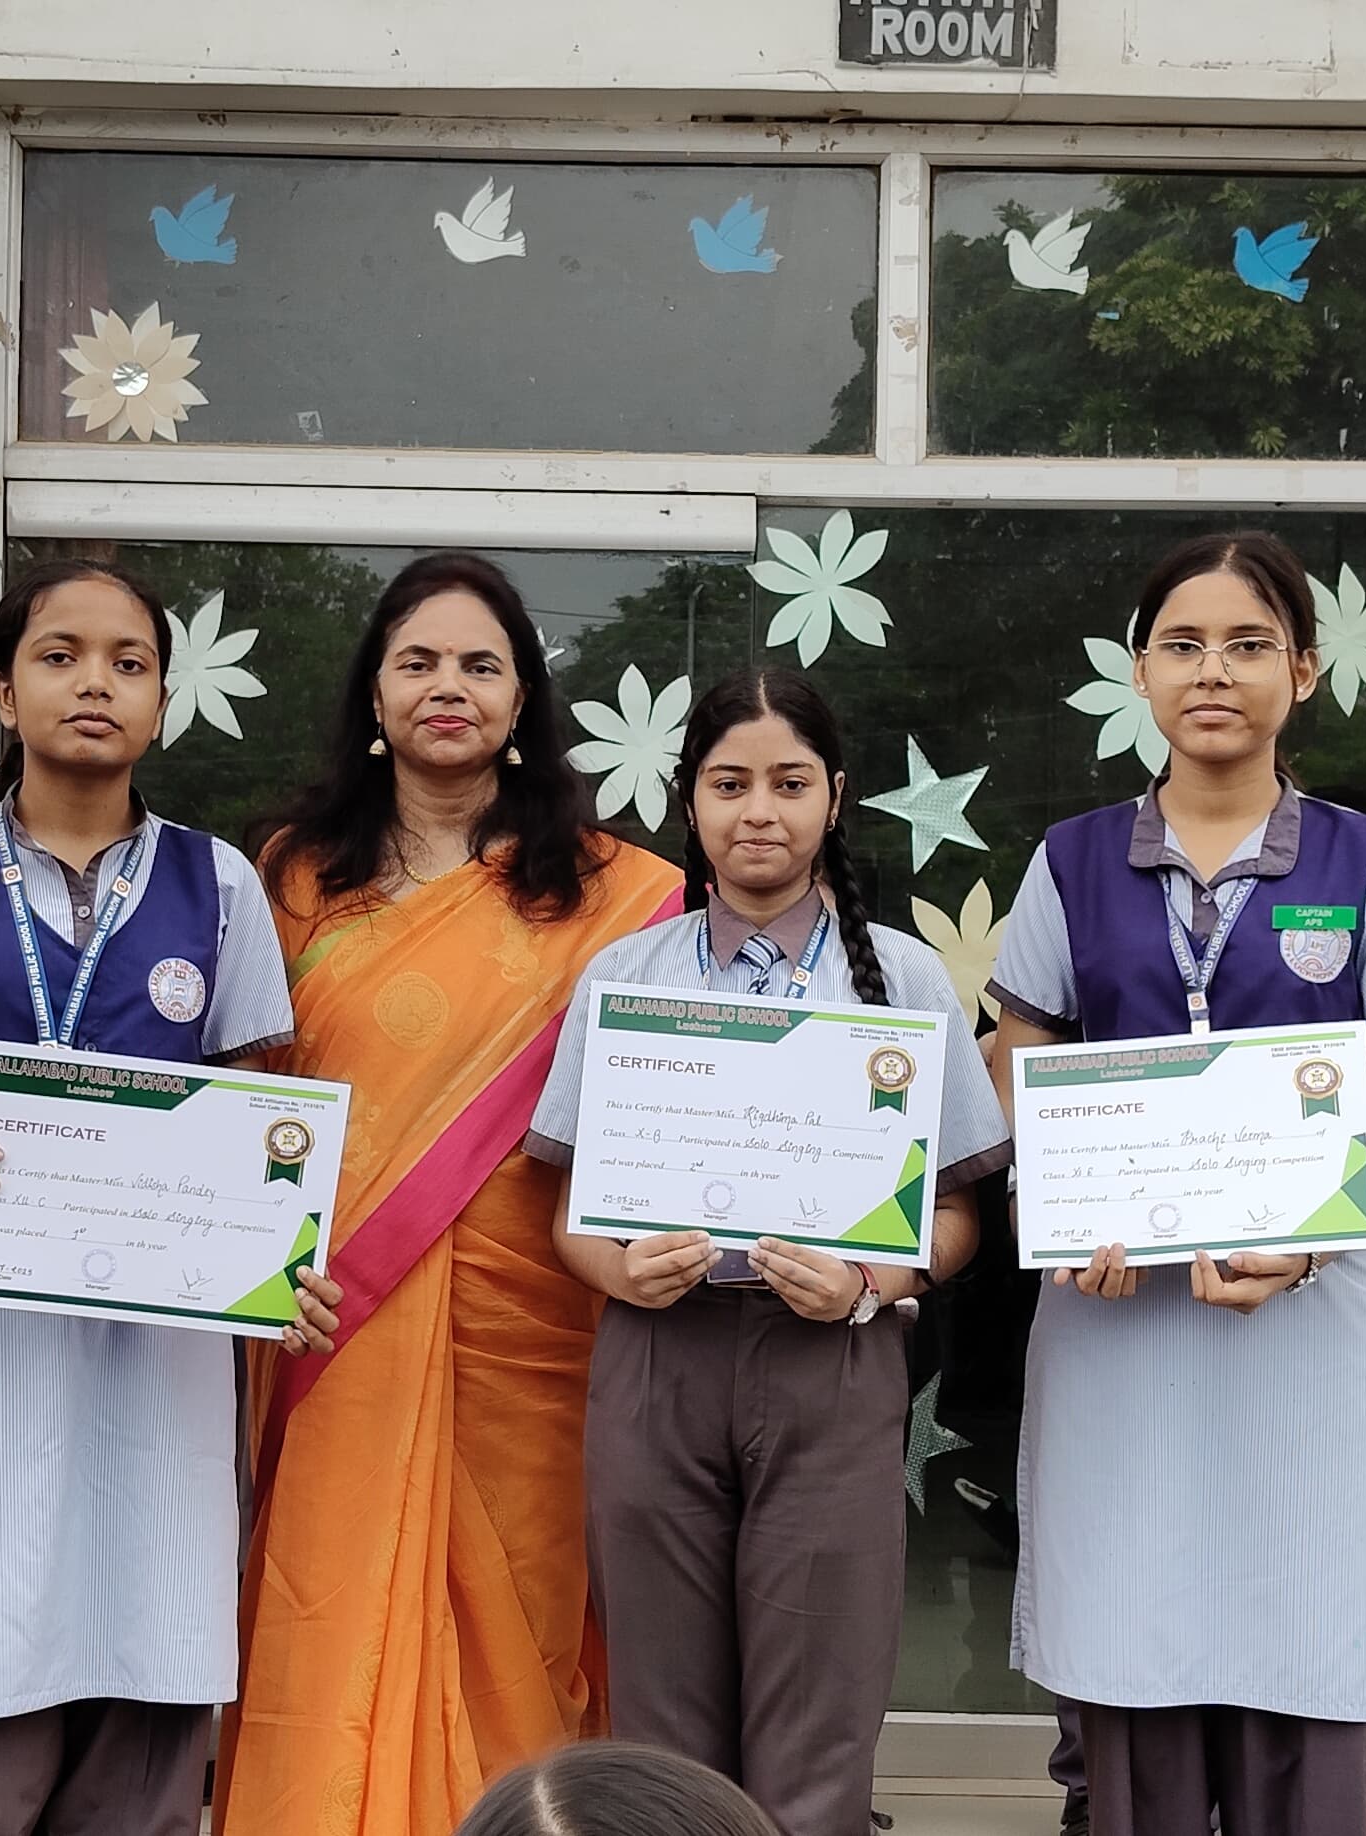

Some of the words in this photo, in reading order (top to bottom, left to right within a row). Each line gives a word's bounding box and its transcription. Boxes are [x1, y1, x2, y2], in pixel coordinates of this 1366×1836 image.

[871, 7, 1015, 57] ROOM
[10, 885, 27, 921] LUCKNOW
[1295, 909, 1333, 917] CAPTAIN
[1208, 921, 1228, 959] PUBLIC
[1224, 884, 1251, 920] SCHOOL
[1304, 919, 1323, 927] APS
[20, 922, 35, 954] SCHOOL
[1171, 926, 1197, 987] ALLAHABAD
[26, 955, 42, 985] PUBLIC
[60, 990, 83, 1043] ALLAHABAD
[76, 957, 94, 991] PUBLIC
[86, 929, 106, 958] SCHOOL
[34, 986, 52, 1038] ALLAHABAD
[606, 995, 687, 1019] ALLAHABAD
[686, 1001, 736, 1023] PUBLIC
[735, 1006, 793, 1028] SCHOOL
[675, 1019, 722, 1034] Lucknow
[607, 1053, 716, 1076] CERTIFICATE
[1031, 1053, 1108, 1073] ALLAHABAD
[1107, 1049, 1156, 1067] PUBLIC
[1156, 1044, 1212, 1063] SCHOOL
[77, 1065, 131, 1089] PUBLIC
[130, 1071, 190, 1095] SCHOOL
[65, 1083, 115, 1099] Lucknow
[605, 1099, 623, 1109] This
[624, 1101, 632, 1110] is
[634, 1102, 663, 1114] Certify
[664, 1104, 682, 1115] that
[1037, 1101, 1145, 1120] CERTIFICATE
[602, 1127, 626, 1138] Class
[678, 1134, 730, 1149] Participated
[732, 1140, 741, 1148] in
[832, 1147, 884, 1163] Competition
[1041, 1147, 1058, 1156] This
[1060, 1146, 1067, 1154] is
[1069, 1144, 1098, 1155] Certify
[1099, 1143, 1116, 1152] that
[7, 1165, 16, 1175] is
[17, 1166, 48, 1180] Certify
[49, 1170, 68, 1181] that
[599, 1156, 616, 1166] and
[617, 1159, 634, 1167] was
[634, 1159, 665, 1171] placed
[740, 1169, 749, 1177] in
[1042, 1172, 1065, 1181] Class
[1117, 1165, 1168, 1177] Participated
[1170, 1164, 1179, 1172] in
[1272, 1153, 1324, 1166] Competition
[1043, 1197, 1059, 1206] and
[1061, 1197, 1077, 1205] was
[1077, 1194, 1108, 1204] placed
[62, 1201, 117, 1217] Participated
[119, 1208, 128, 1217] in
[222, 1219, 276, 1235] Competition
[703, 1212, 729, 1222] Manager
[791, 1220, 817, 1230] Principal
[14, 1226, 47, 1239] placed
[125, 1239, 135, 1247] in
[1152, 1231, 1177, 1240] Manager
[1241, 1224, 1267, 1233] Principal
[84, 1283, 111, 1293] Manager
[175, 1292, 202, 1303] Principal
